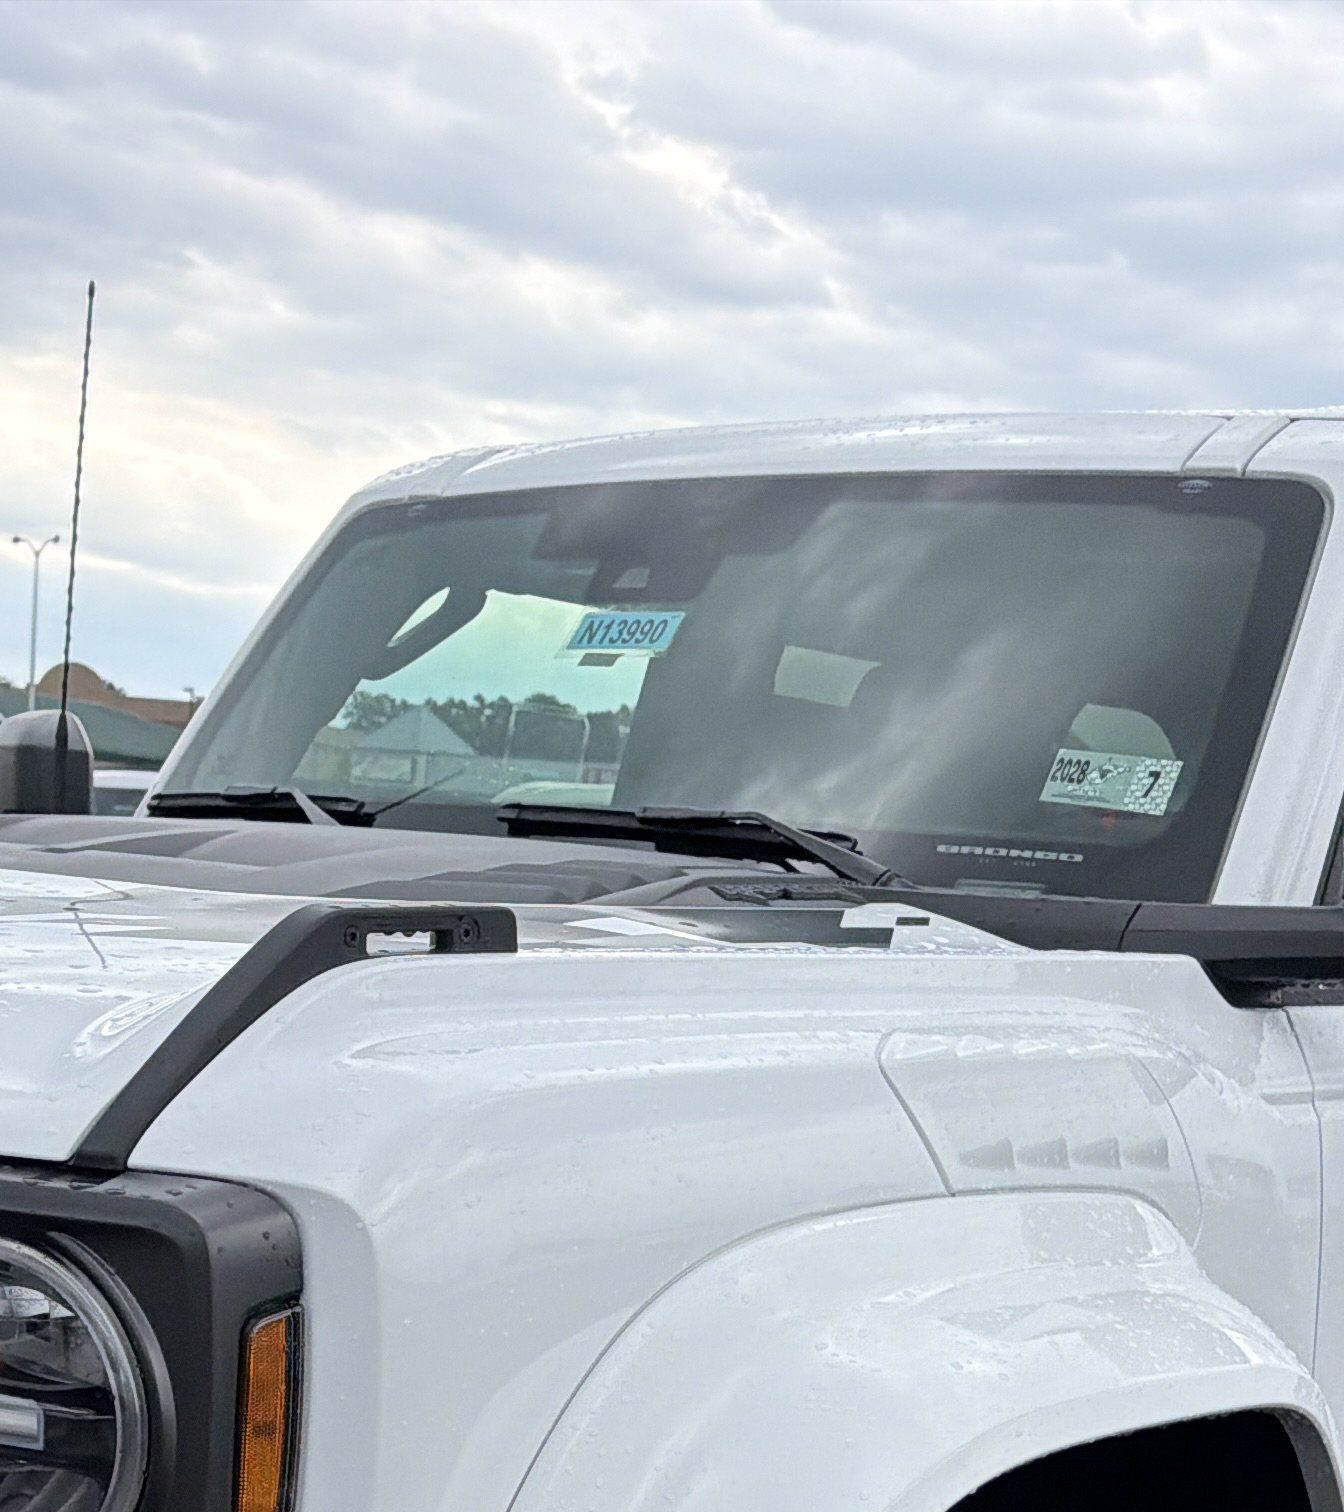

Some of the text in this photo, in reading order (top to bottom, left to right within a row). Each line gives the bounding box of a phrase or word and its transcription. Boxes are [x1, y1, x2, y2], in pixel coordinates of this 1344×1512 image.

[577, 618, 669, 645] N13990
[1050, 757, 1162, 799] 2028 7
[937, 844, 1084, 862] BRONCO
